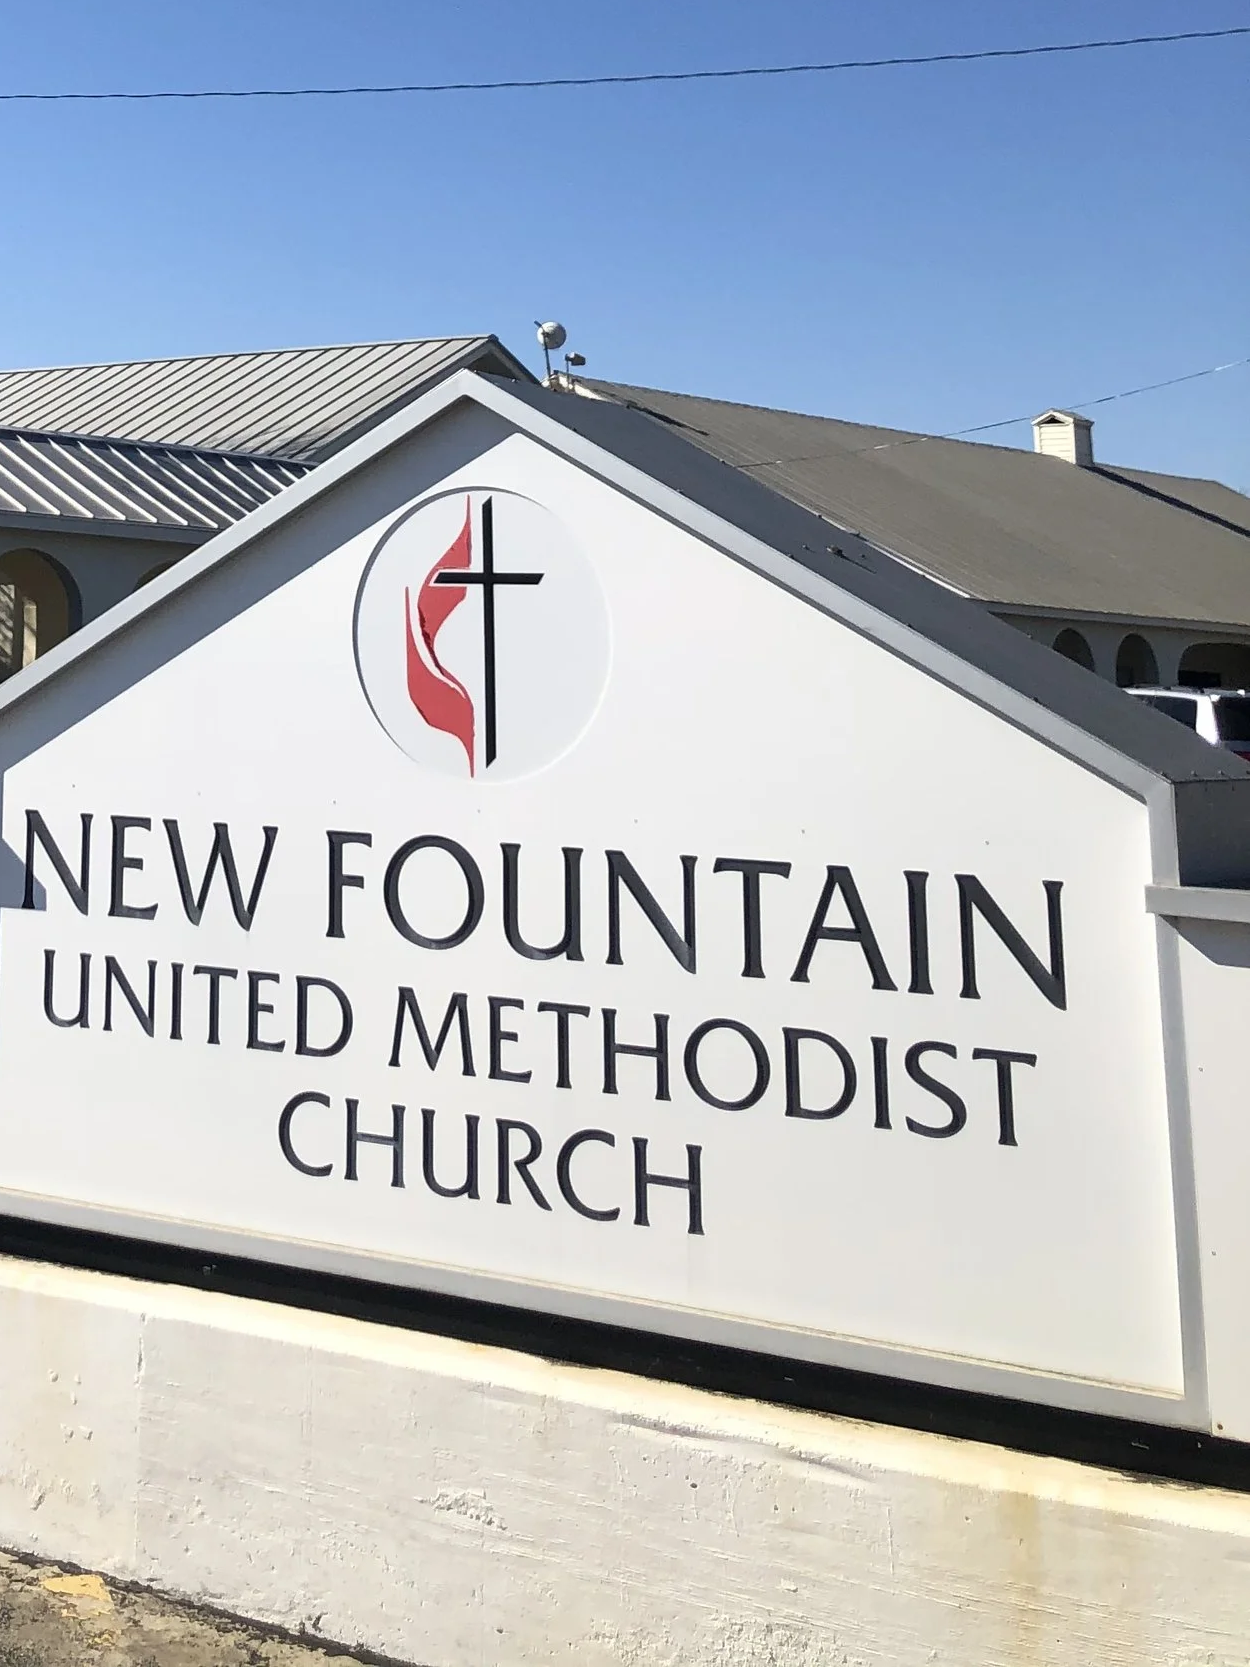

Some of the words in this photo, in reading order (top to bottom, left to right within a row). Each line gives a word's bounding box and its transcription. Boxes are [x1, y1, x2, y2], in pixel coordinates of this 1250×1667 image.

[20, 809, 279, 932] NEW
[325, 830, 1067, 1011] FOUNTAIN
[43, 949, 353, 1058] UNITED
[388, 986, 1038, 1147] METHODIST
[278, 1091, 704, 1236] CHURCH
